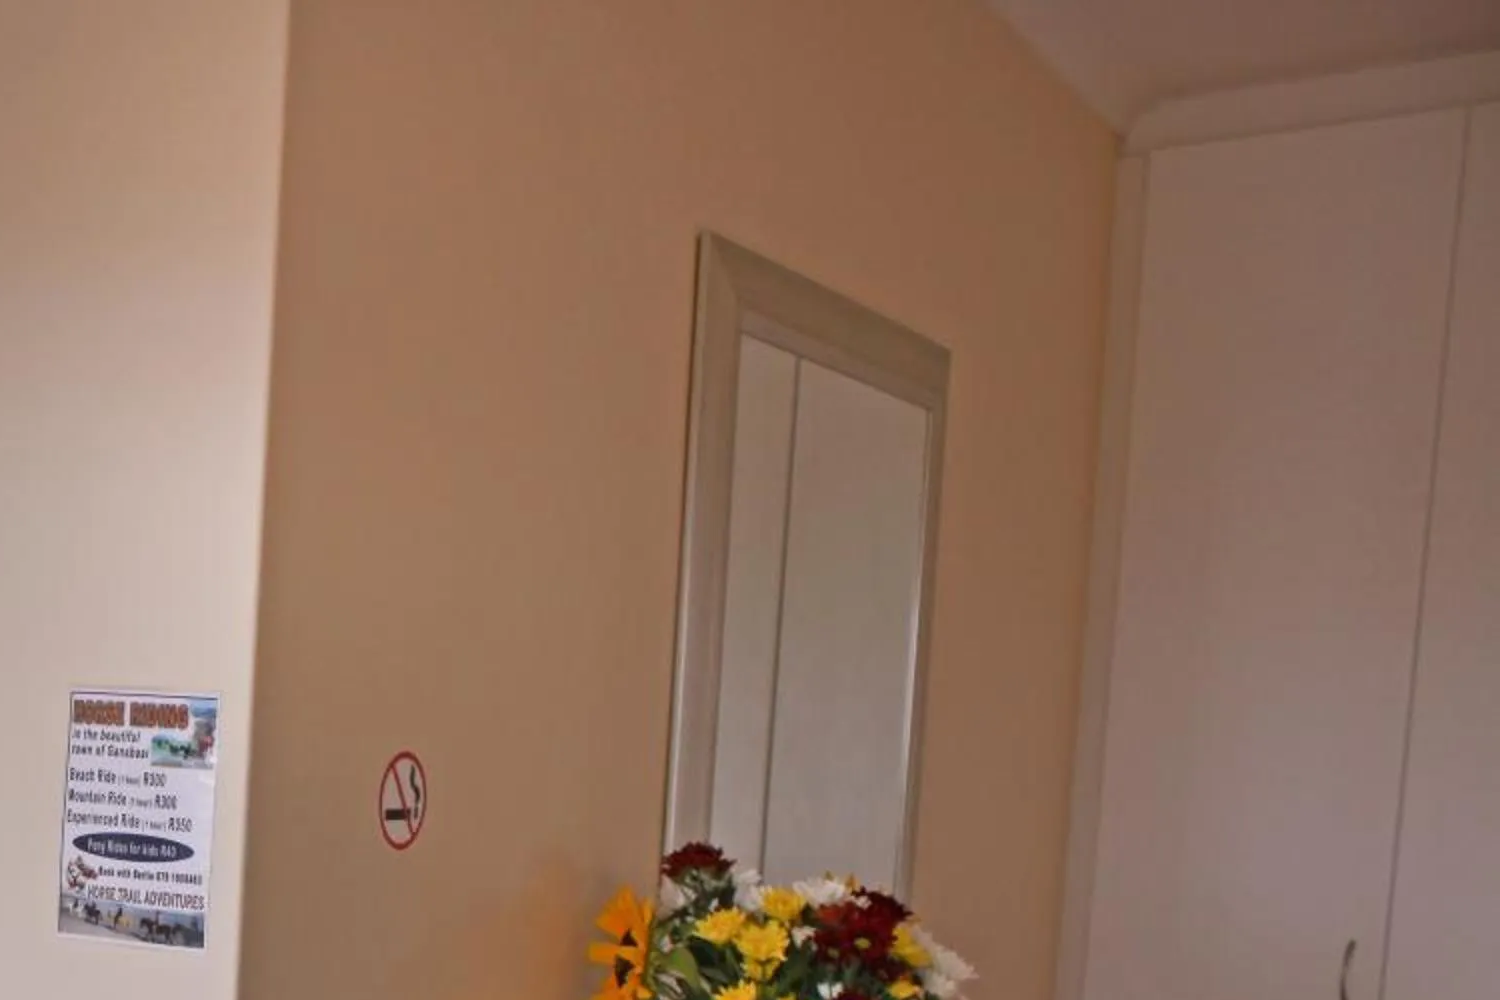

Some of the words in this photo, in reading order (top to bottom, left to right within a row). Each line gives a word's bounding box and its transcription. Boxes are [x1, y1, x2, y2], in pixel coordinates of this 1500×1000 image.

[83, 728, 98, 741] the
[100, 730, 141, 743] beautiful
[95, 745, 105, 756] of
[69, 767, 95, 782] Beach
[97, 769, 117, 784] Ride
[68, 788, 106, 804] Mountain
[108, 791, 127, 806] Ride
[67, 808, 119, 827] Experienced
[121, 813, 140, 829] Ride
[129, 841, 141, 854] for
[87, 884, 116, 901] HORSE
[118, 887, 143, 905] TRAIL
[144, 890, 204, 911] ADVENTURES
